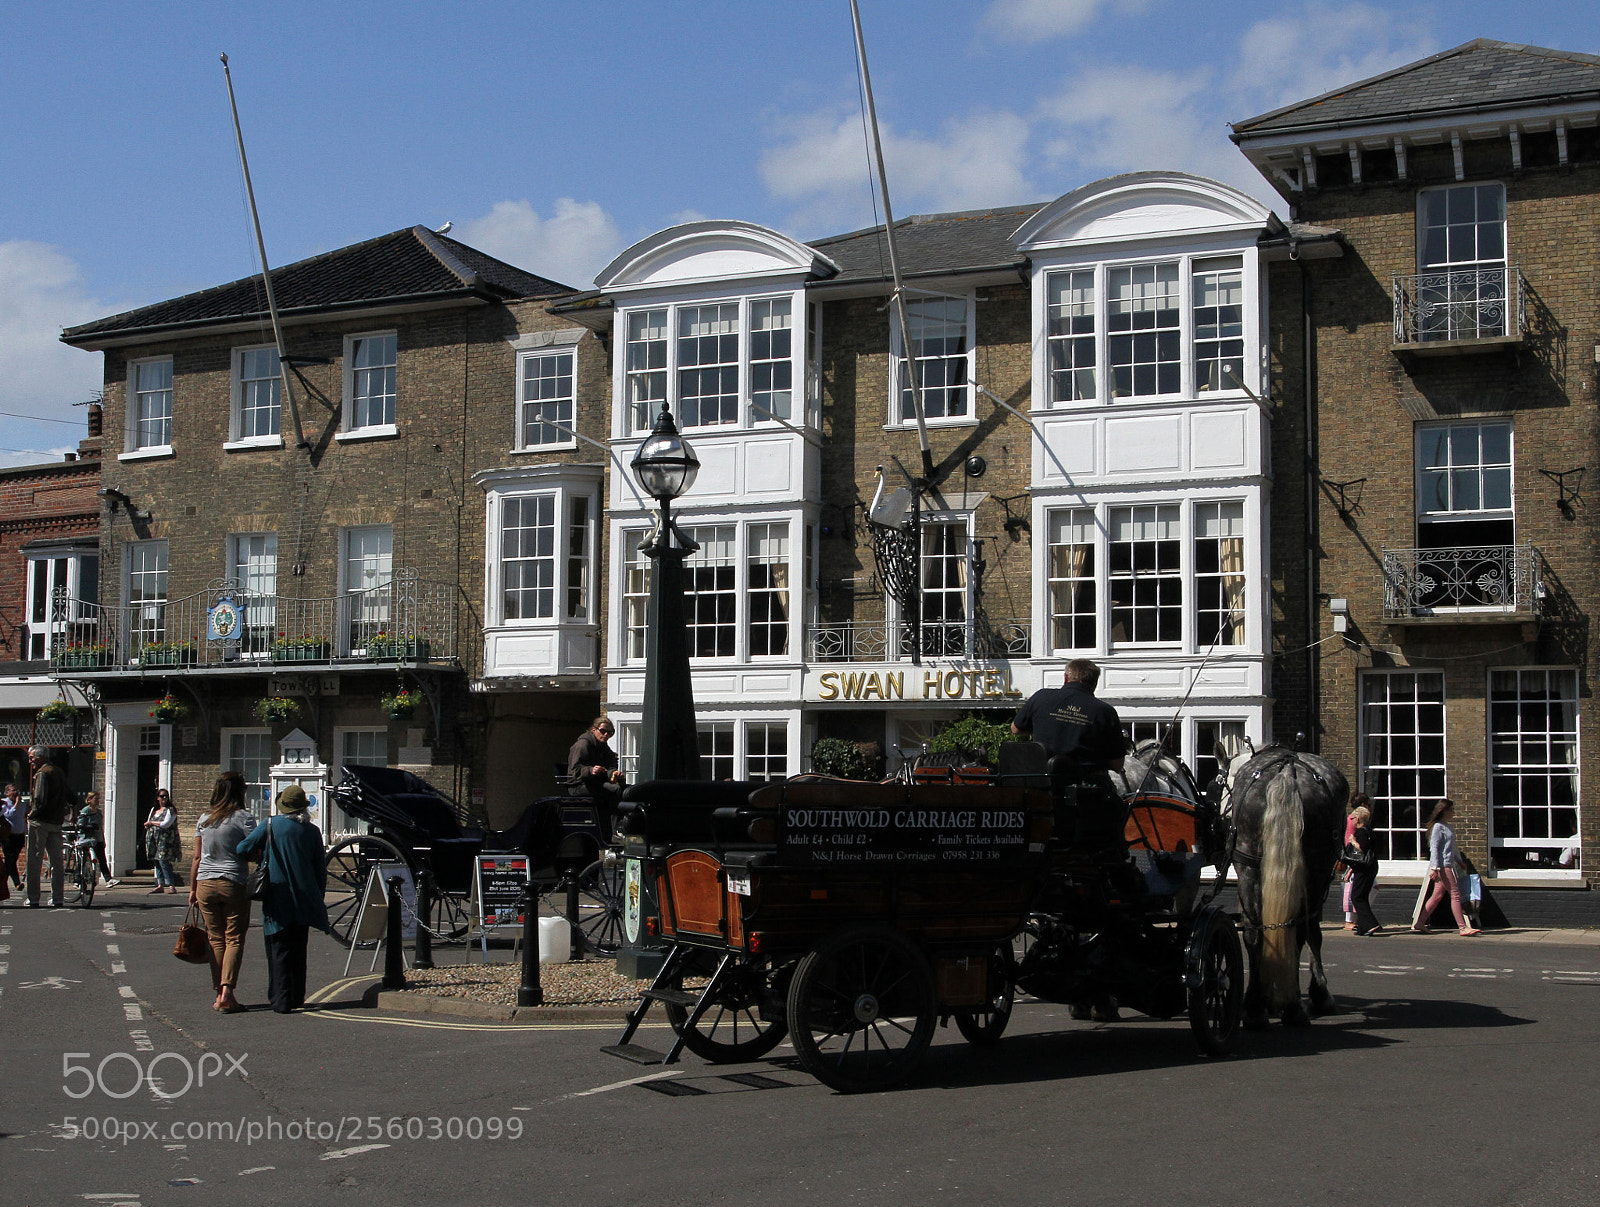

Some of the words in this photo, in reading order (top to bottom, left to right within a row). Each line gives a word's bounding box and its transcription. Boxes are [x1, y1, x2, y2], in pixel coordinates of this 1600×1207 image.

[307, 680, 336, 691] HLL
[818, 670, 904, 700] SWAN
[923, 669, 1023, 699] HOTEL
[786, 809, 890, 828] SOUTHWOLD
[894, 810, 977, 828] CARRIAGE
[981, 811, 1025, 828] RIDES
[786, 834, 809, 845] Adult
[812, 834, 823, 845] £4
[831, 834, 854, 845] Child
[856, 834, 867, 845] £2
[938, 834, 962, 846] Family
[965, 834, 991, 845] Tickets
[993, 834, 1025, 845] Available
[812, 851, 833, 861] N&J
[837, 851, 862, 860] Horse
[865, 851, 893, 860] Drawn
[896, 850, 936, 862] Carriages
[942, 850, 968, 860] 07958
[970, 850, 983, 860] 231
[986, 850, 1000, 860] 336
